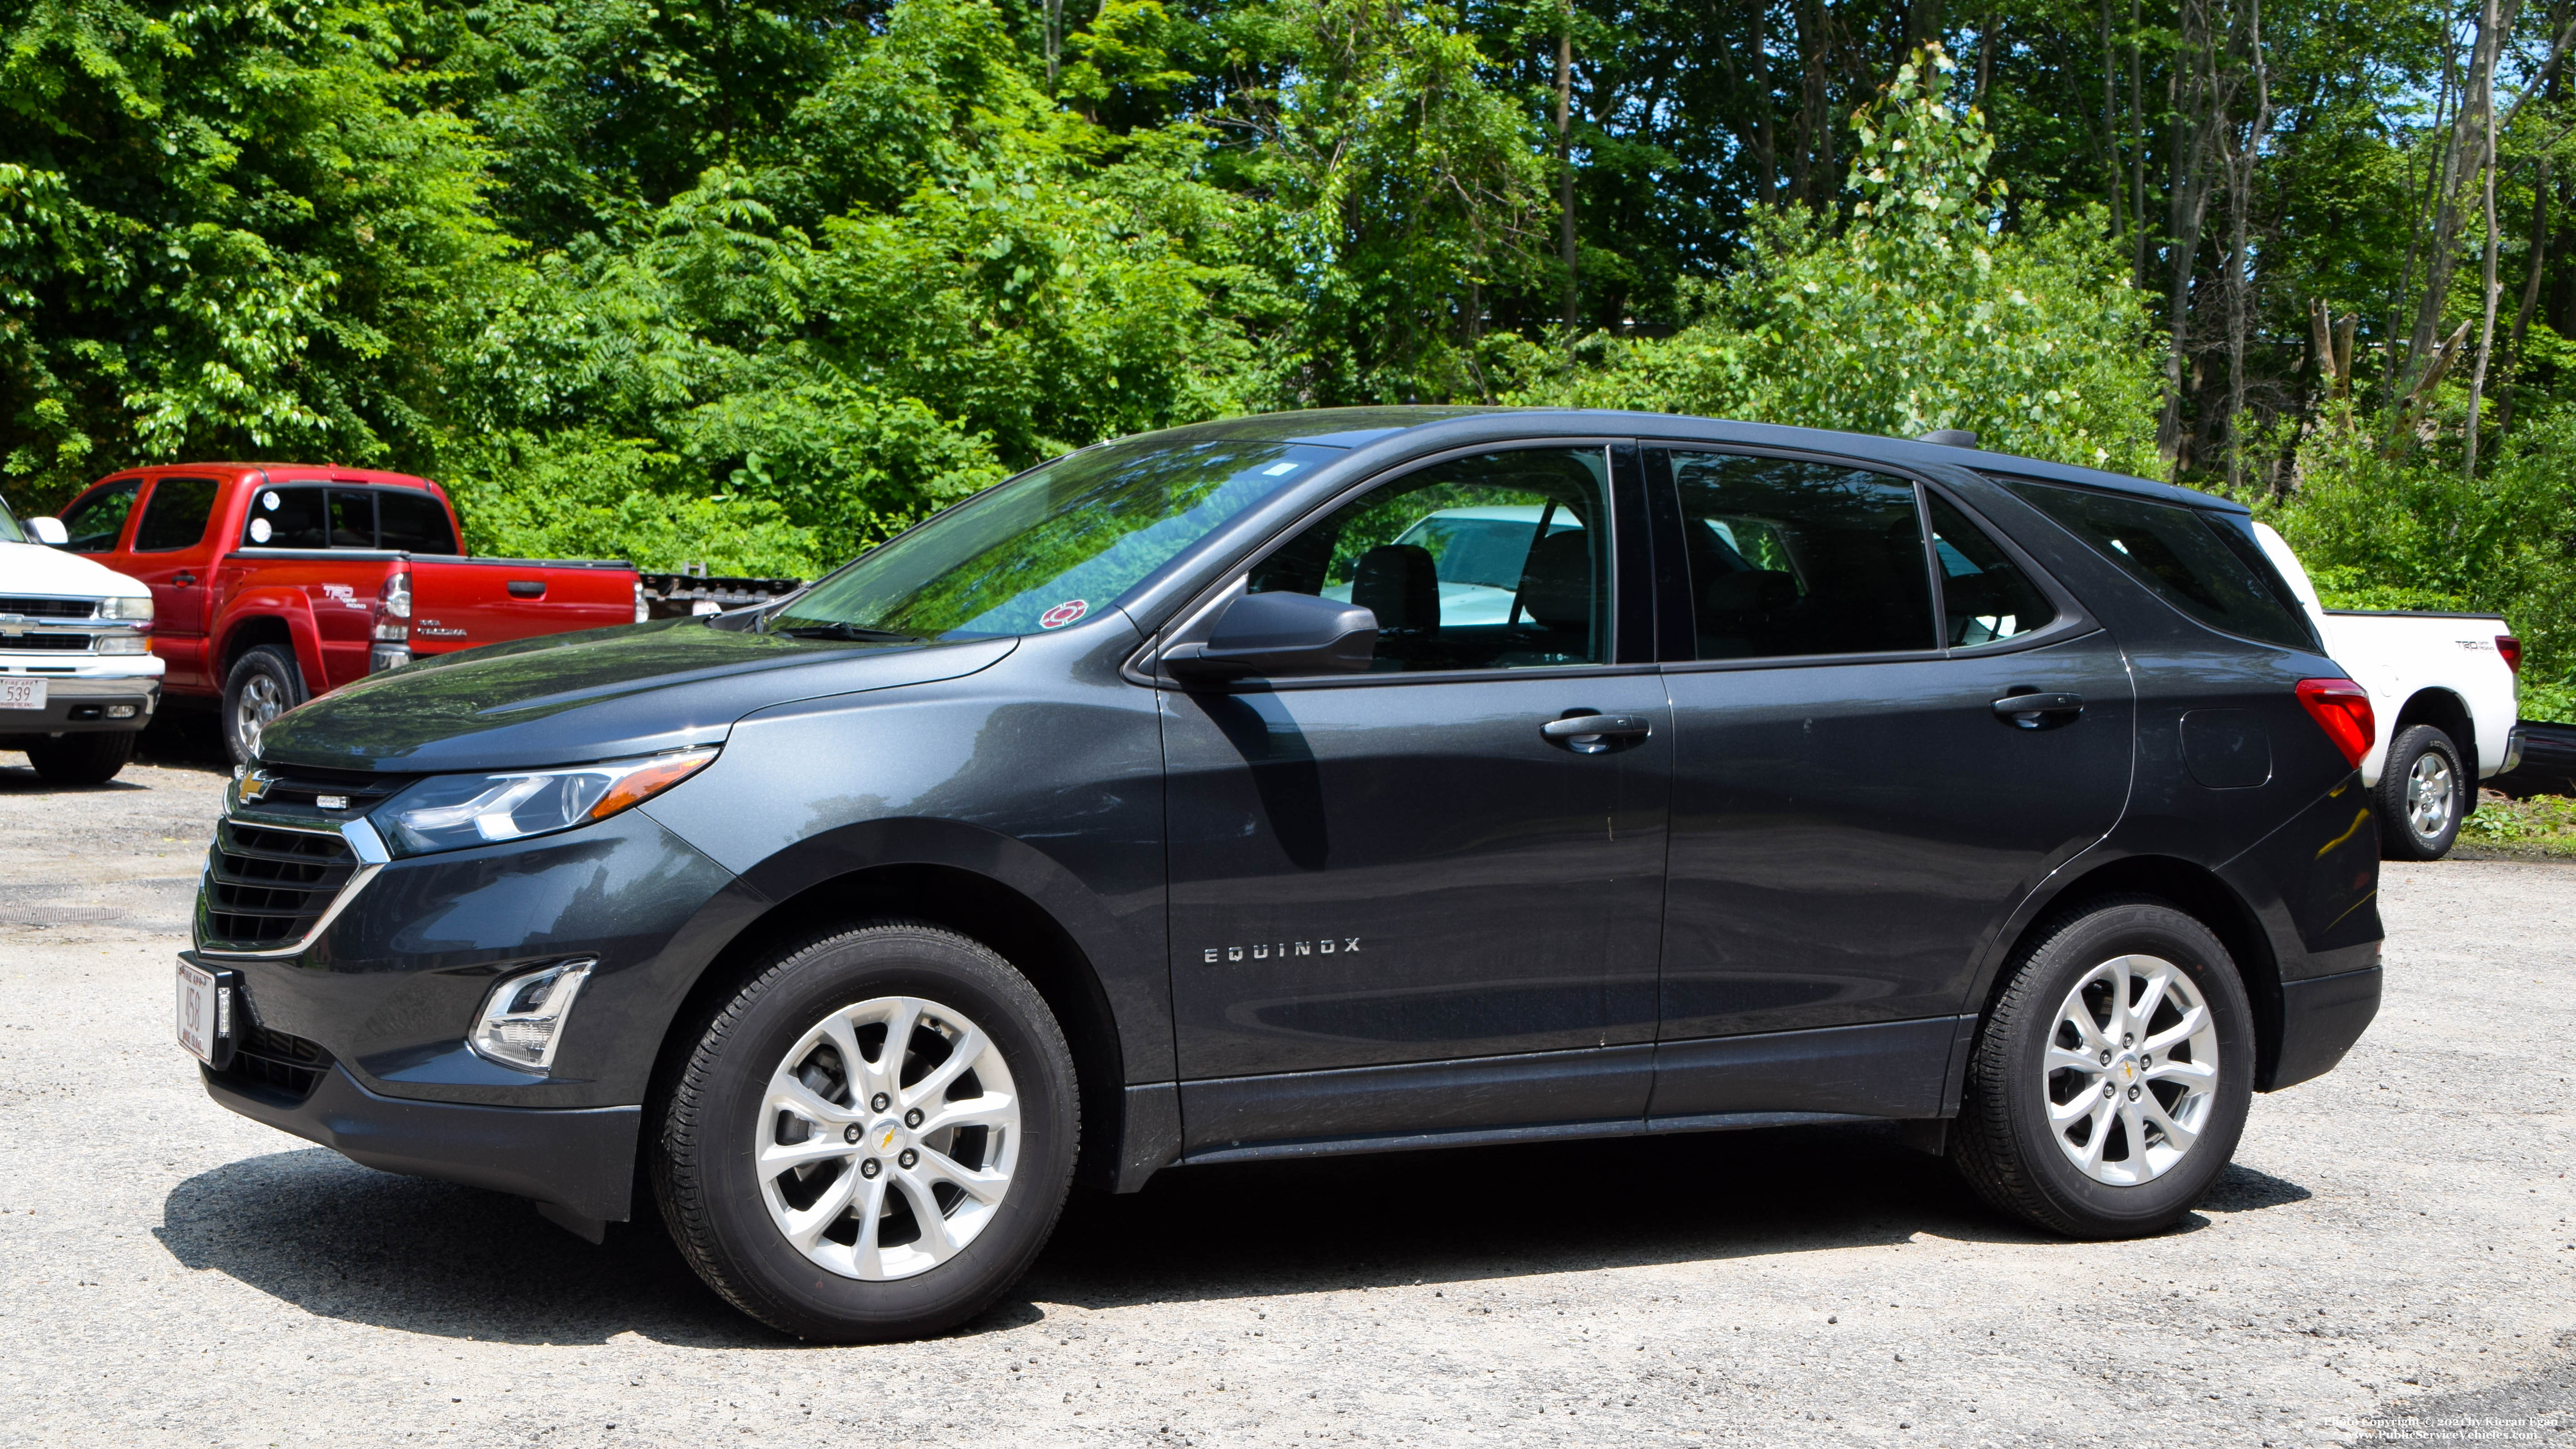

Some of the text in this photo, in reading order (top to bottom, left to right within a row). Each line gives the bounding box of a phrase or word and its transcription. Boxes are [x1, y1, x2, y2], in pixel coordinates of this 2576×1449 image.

[323, 586, 354, 600] TRD
[2455, 641, 2478, 651] TRD
[7, 686, 30, 700] 539
[1204, 938, 1360, 963] EQUINOX
[185, 986, 200, 1032] 458
